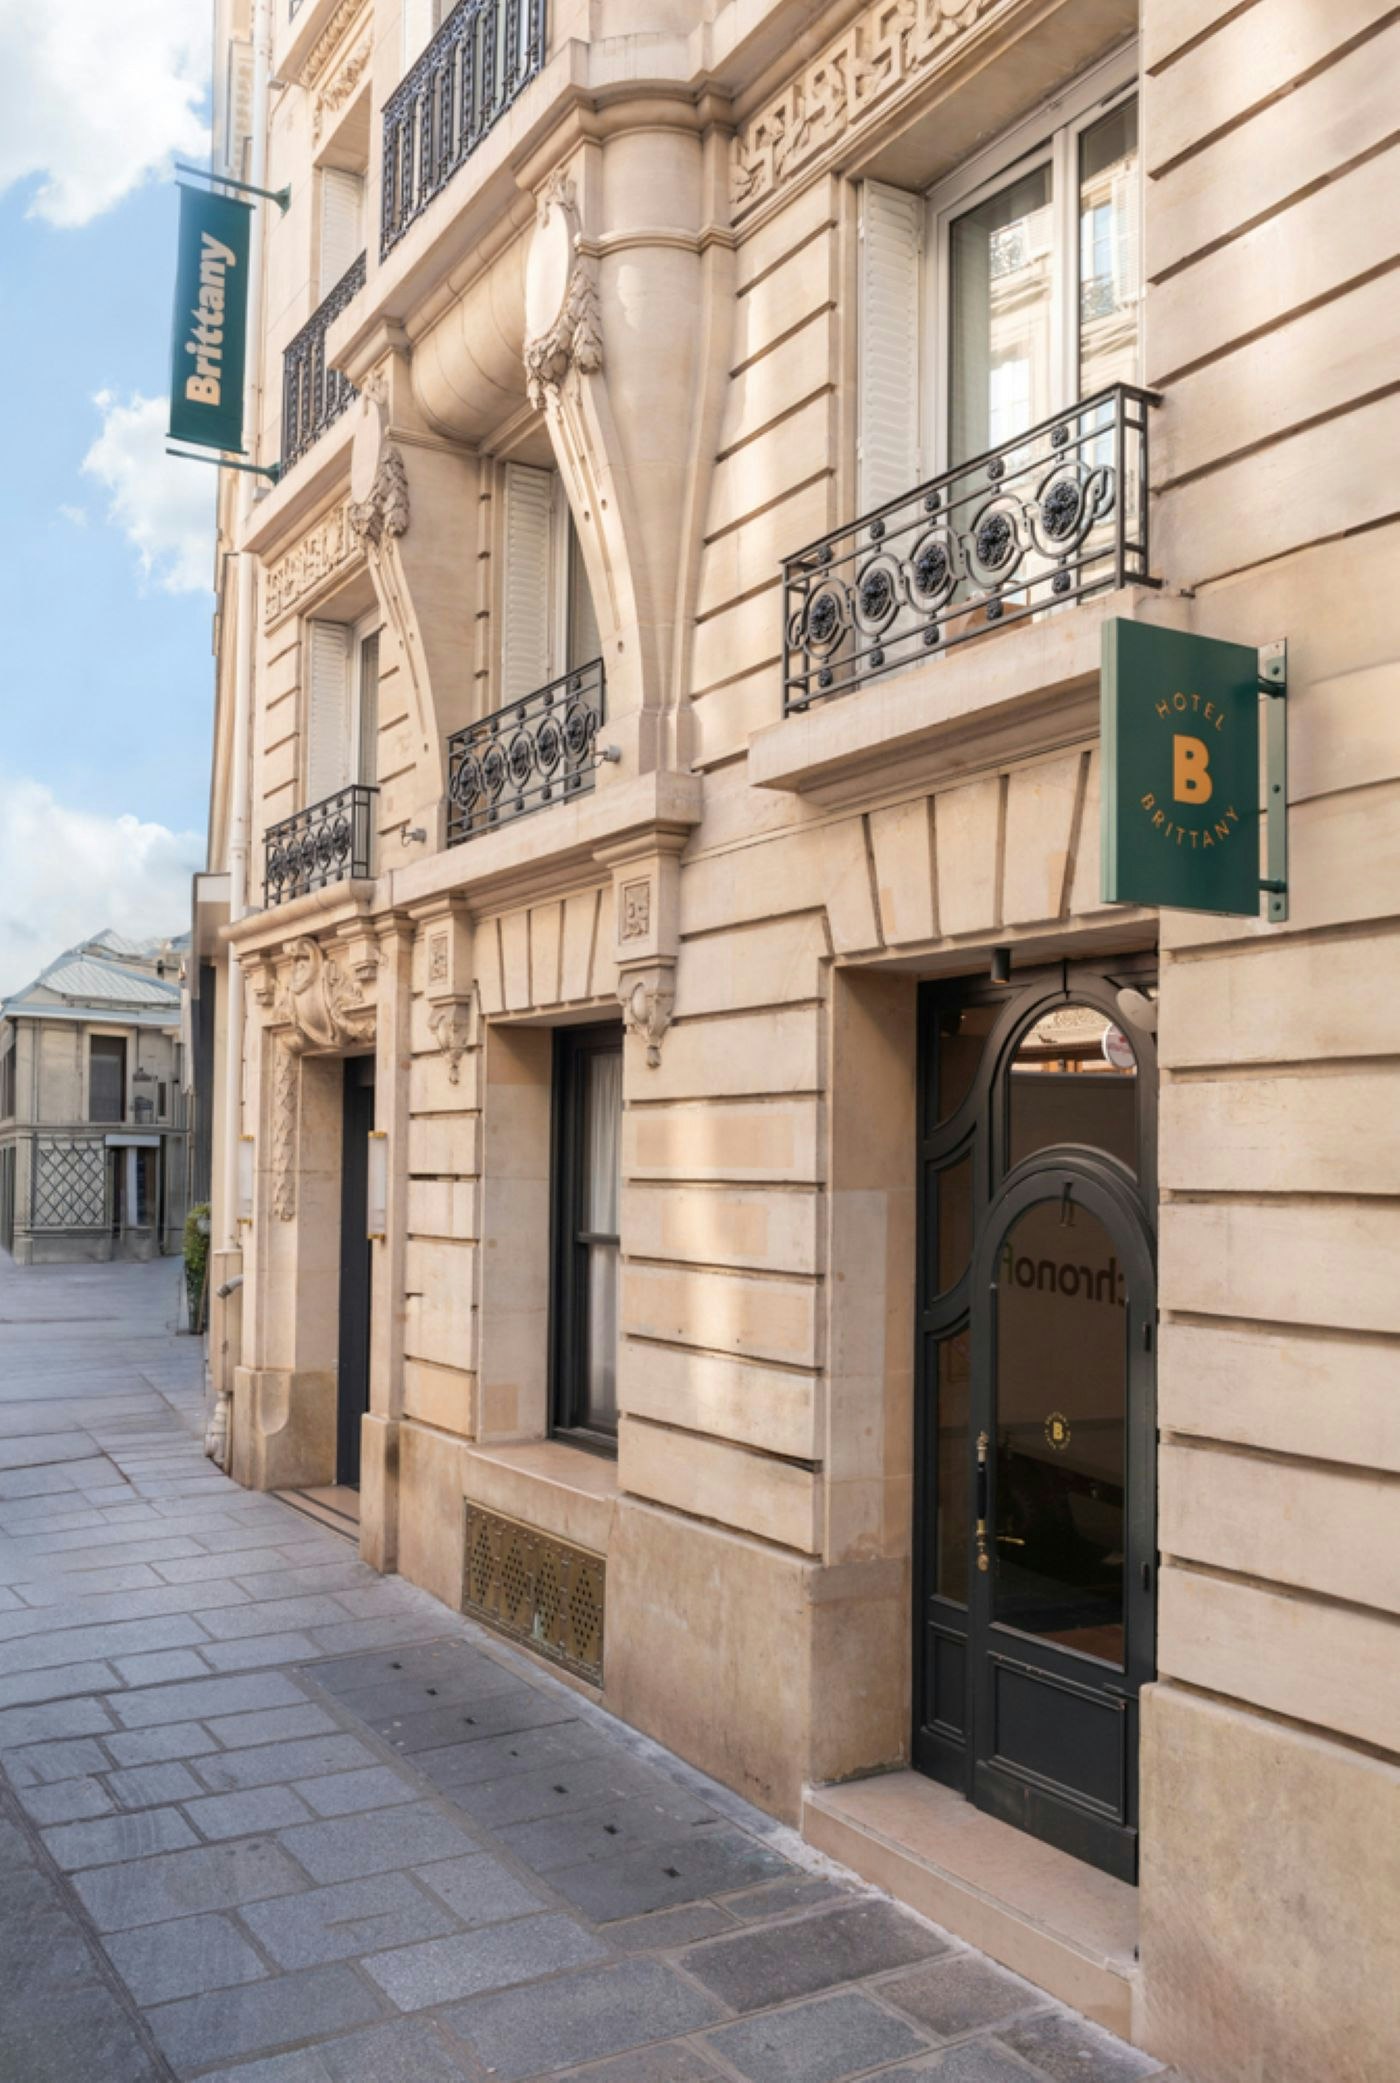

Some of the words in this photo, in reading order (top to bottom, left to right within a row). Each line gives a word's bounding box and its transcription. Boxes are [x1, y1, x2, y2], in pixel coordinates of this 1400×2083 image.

[185, 232, 237, 406] Brittany
[1155, 691, 1225, 731] HOTEL
[1173, 734, 1213, 805] B
[1140, 792, 1239, 848] BRITTANY
[1053, 1421, 1064, 1440] B
